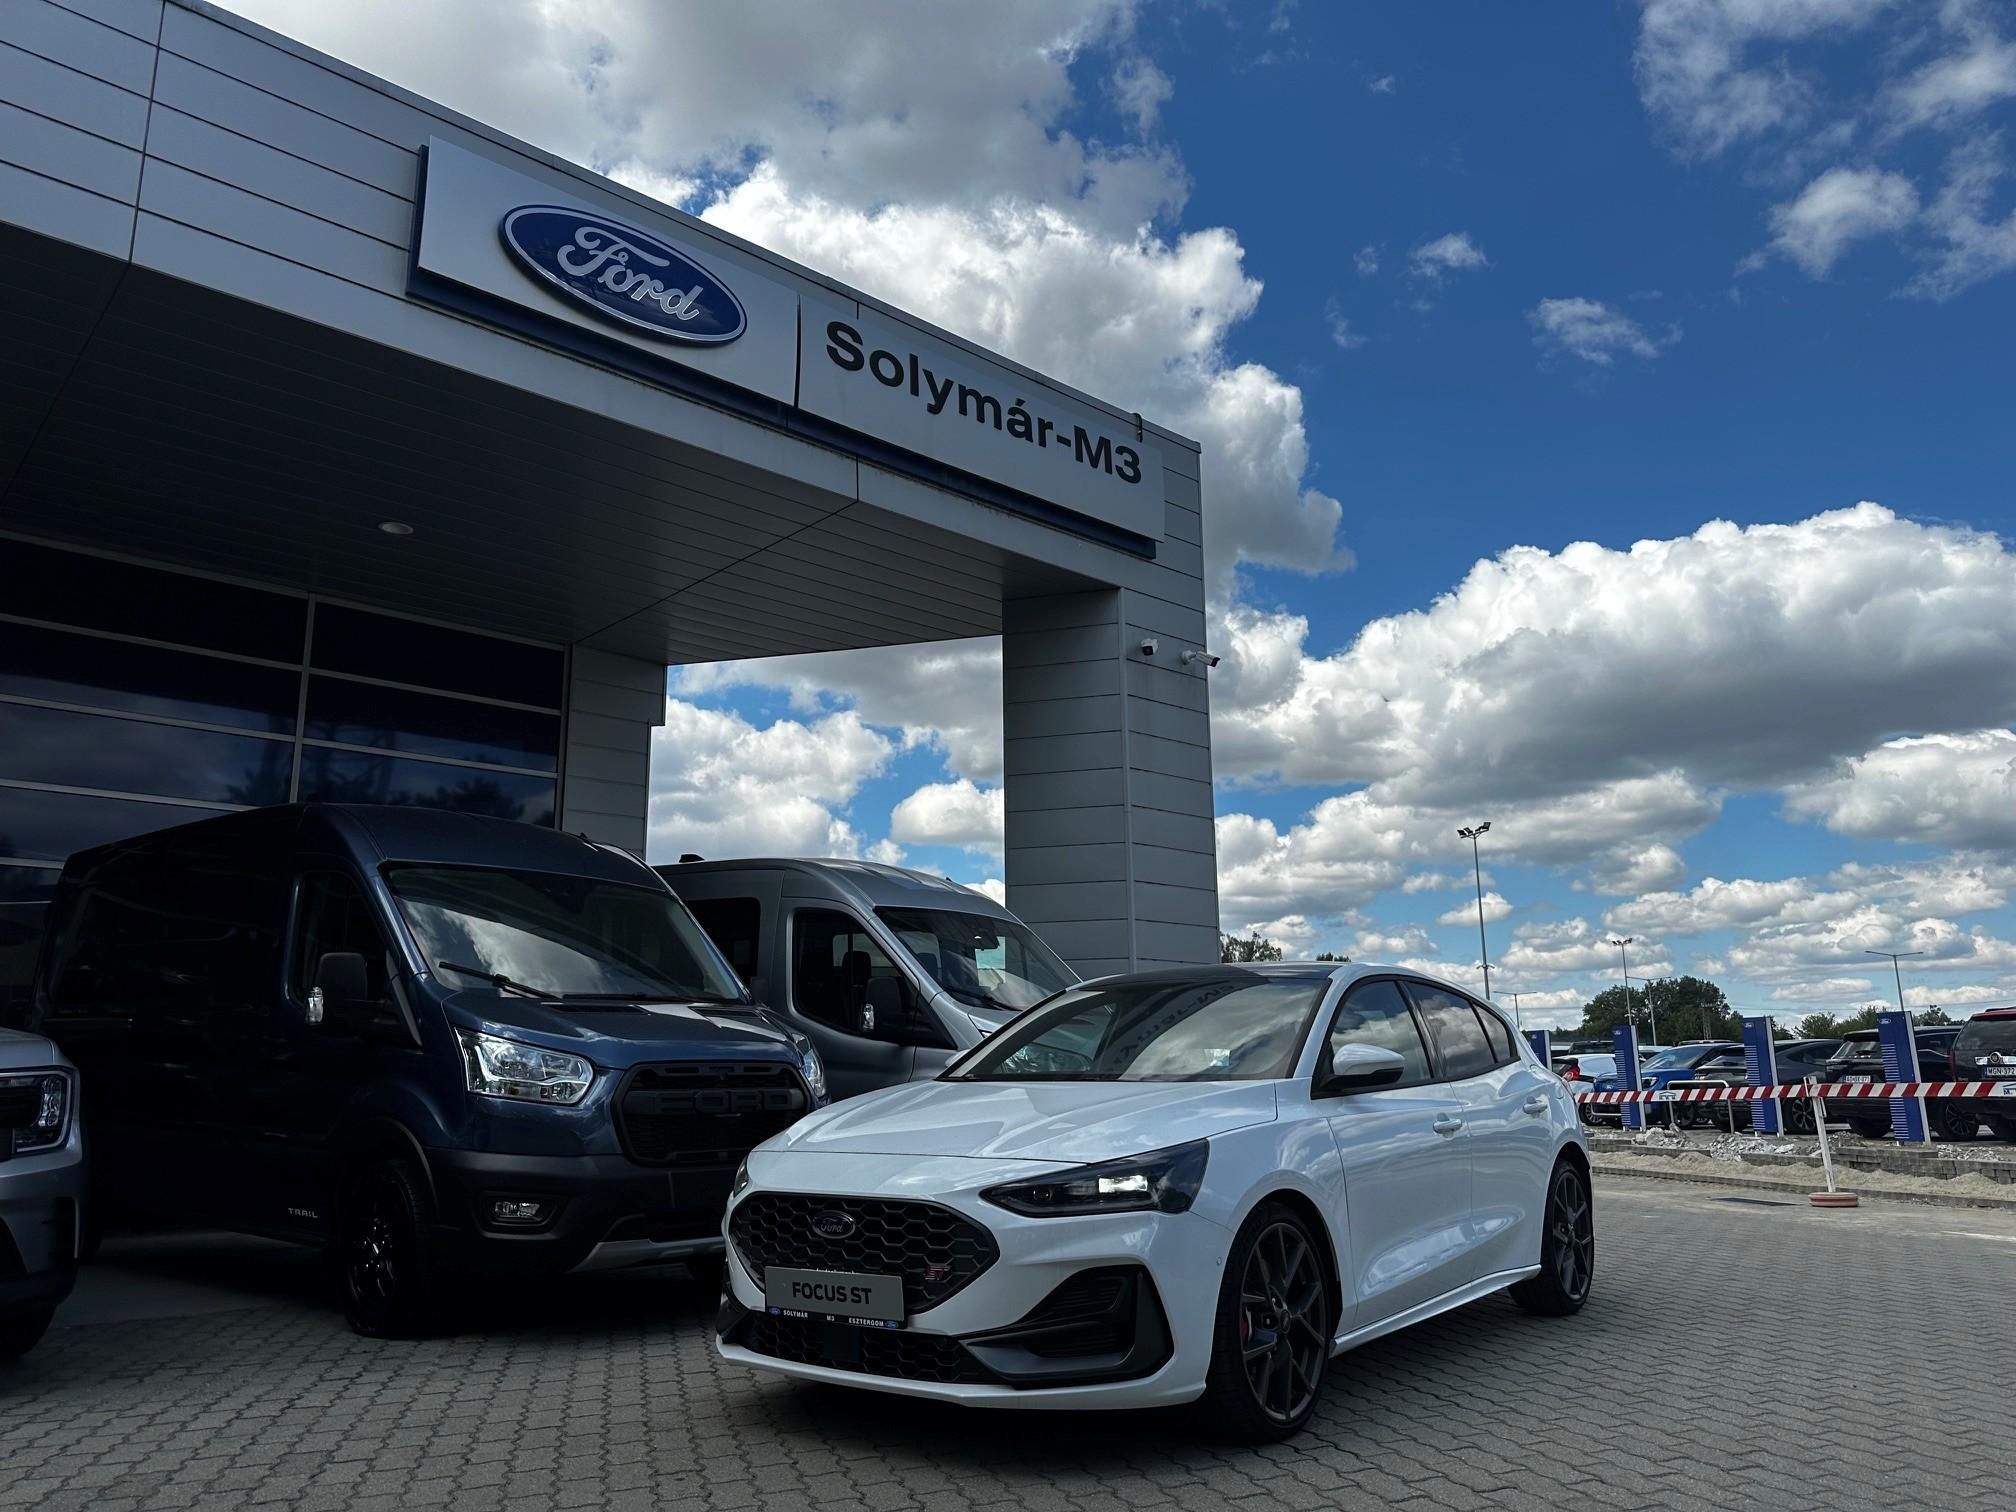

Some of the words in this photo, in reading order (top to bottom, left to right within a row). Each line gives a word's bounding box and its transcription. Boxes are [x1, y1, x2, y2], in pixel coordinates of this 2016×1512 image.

[557, 226, 704, 320] Ford
[826, 321, 1142, 484] Solymár-M3
[288, 1208, 318, 1219] TRAIL
[820, 1217, 844, 1233] Ford
[792, 1282, 848, 1302] FOCUS
[851, 1287, 872, 1304] ST
[848, 1317, 884, 1327] ESZTERGOM
